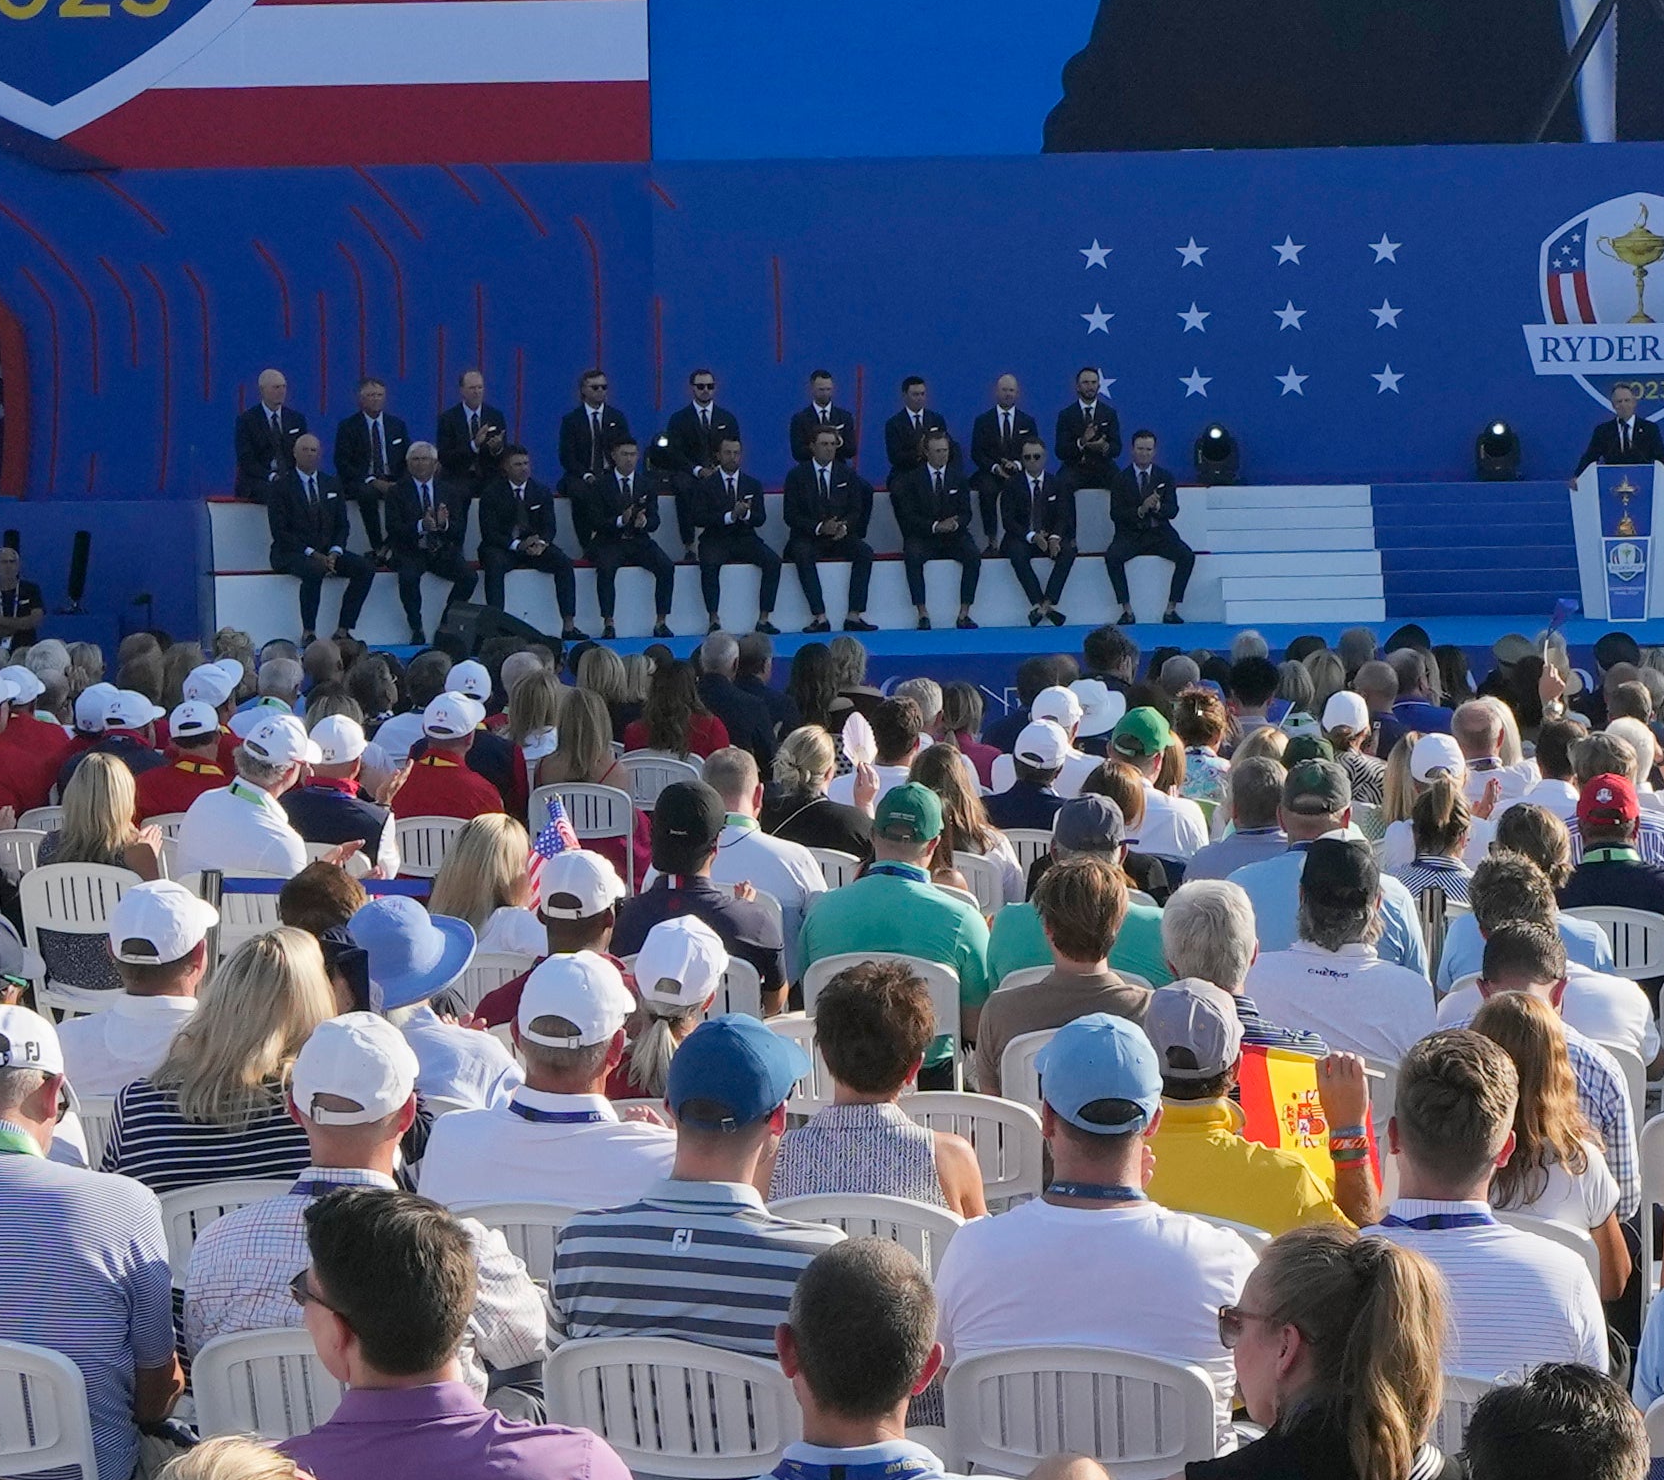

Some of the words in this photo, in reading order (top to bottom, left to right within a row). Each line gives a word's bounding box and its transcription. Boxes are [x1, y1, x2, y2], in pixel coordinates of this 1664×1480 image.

[1539, 335, 1664, 363] RYDER
[24, 1040, 41, 1062] FJ
[671, 1228, 694, 1252] FJ
